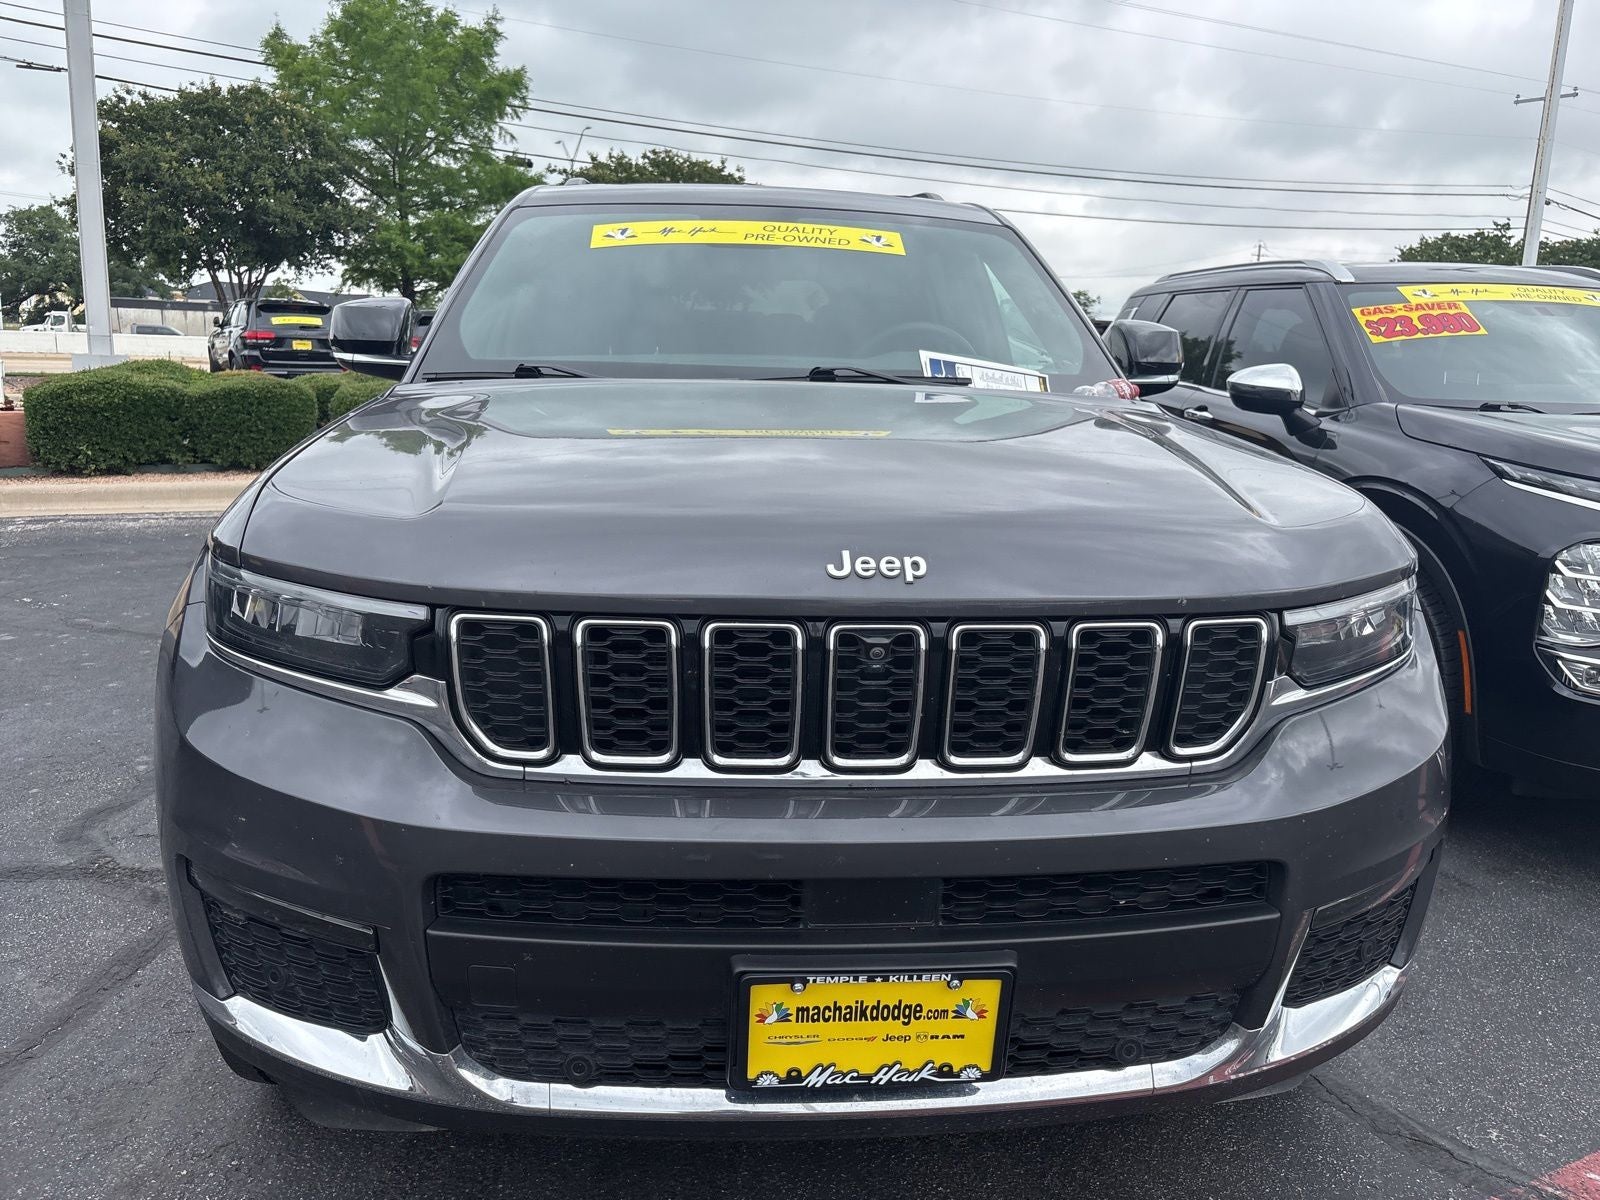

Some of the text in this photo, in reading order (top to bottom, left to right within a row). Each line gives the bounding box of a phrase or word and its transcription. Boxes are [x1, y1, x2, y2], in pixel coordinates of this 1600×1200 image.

[763, 225, 837, 235] QUALITY
[744, 233, 850, 246] PRE-OWNED
[1516, 286, 1566, 296] QUALITY
[1511, 292, 1583, 303] PRE-OWNED
[825, 549, 927, 584] Jeep
[806, 973, 952, 985] TEMPLE KILLEEN
[795, 999, 949, 1026] machaikdodge.com
[882, 1033, 912, 1043] Jeep
[801, 1062, 936, 1088] Mac Haik
